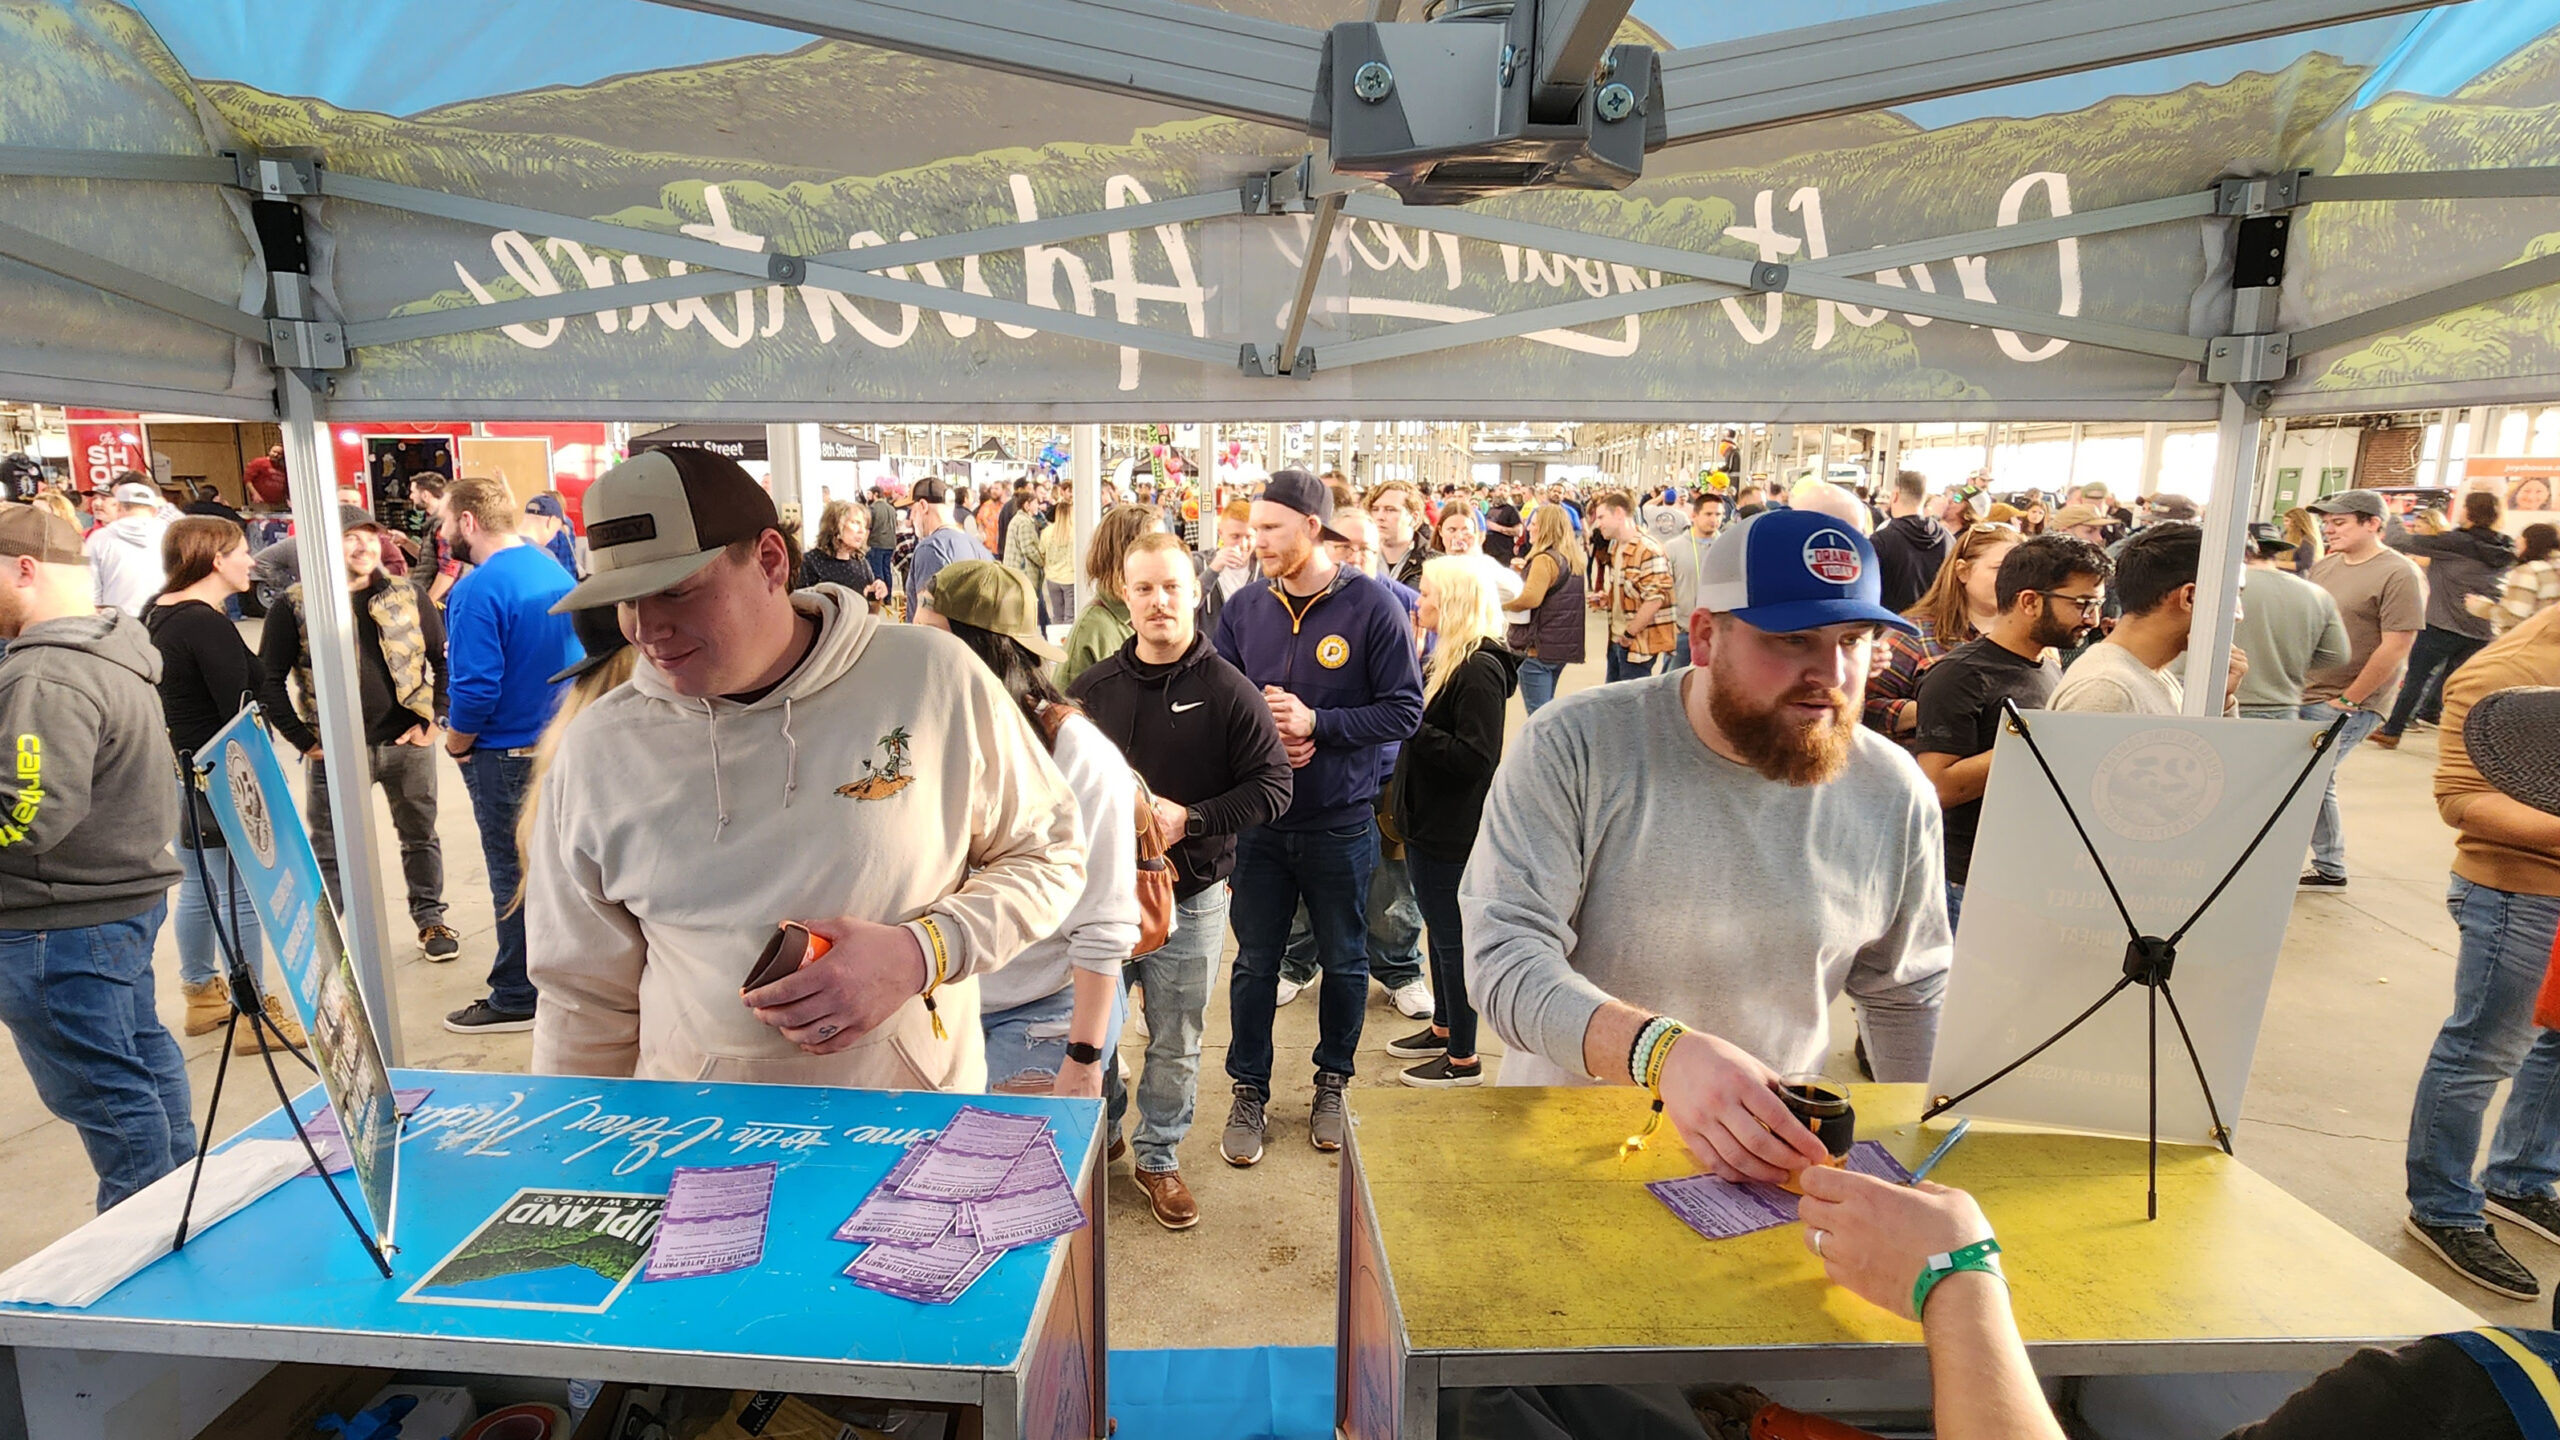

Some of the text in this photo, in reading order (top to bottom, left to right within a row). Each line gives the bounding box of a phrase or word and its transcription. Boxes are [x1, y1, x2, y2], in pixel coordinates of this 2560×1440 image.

[835, 443, 858, 458] Street
[559, 1195, 667, 1209] REWING
[506, 1202, 665, 1247] UPLAND
[848, 1223, 871, 1233] PARTY
[869, 1225, 893, 1235] AFTER
[986, 1232, 1010, 1243] PARTY
[1011, 1228, 1034, 1238] AFTER
[728, 1249, 757, 1261] WINTER
[653, 1261, 679, 1270] PARTY
[679, 1258, 705, 1269] AFTER
[863, 1257, 888, 1270] PARTY
[885, 1263, 908, 1276] AFTER
[922, 1271, 952, 1281] WINTER
